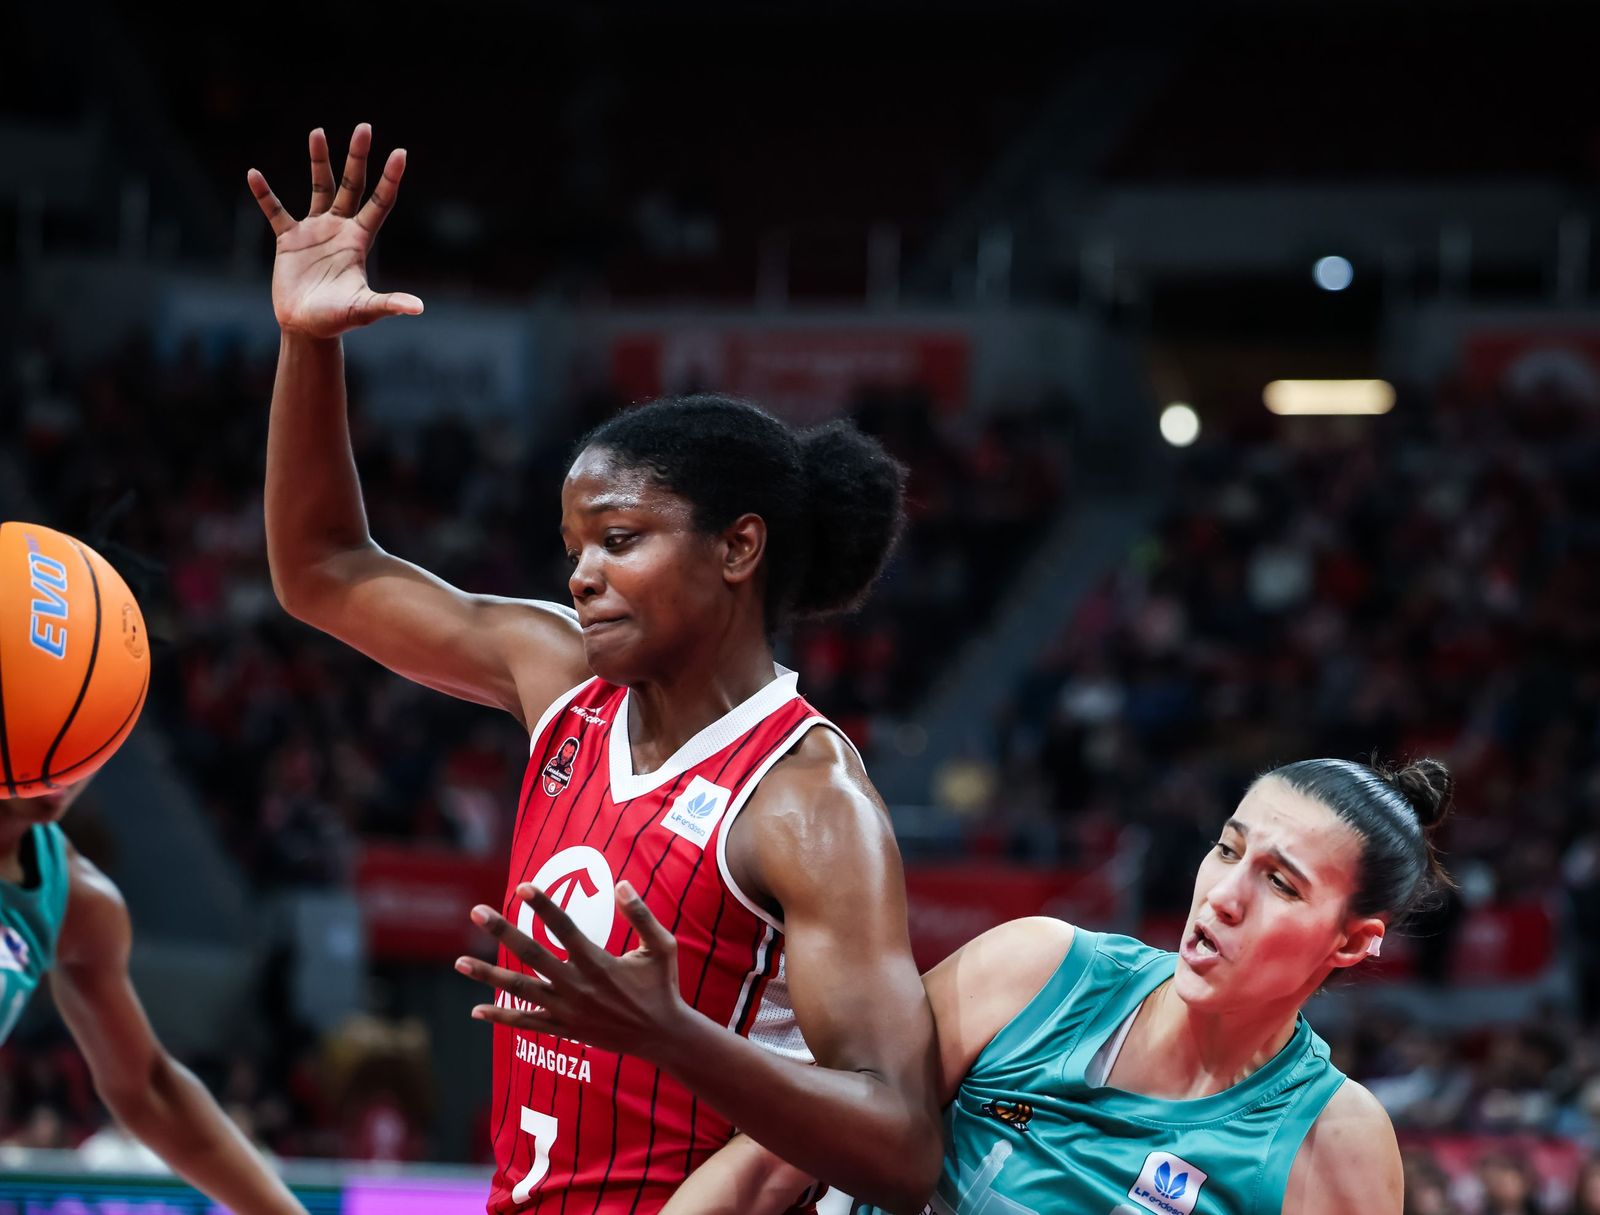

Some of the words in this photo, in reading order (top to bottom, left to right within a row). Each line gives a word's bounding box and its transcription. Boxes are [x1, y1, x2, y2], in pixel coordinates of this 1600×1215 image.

[28, 552, 68, 660] EVO
[515, 1034, 592, 1083] ZARAGOZA
[511, 1104, 559, 1205] 7
